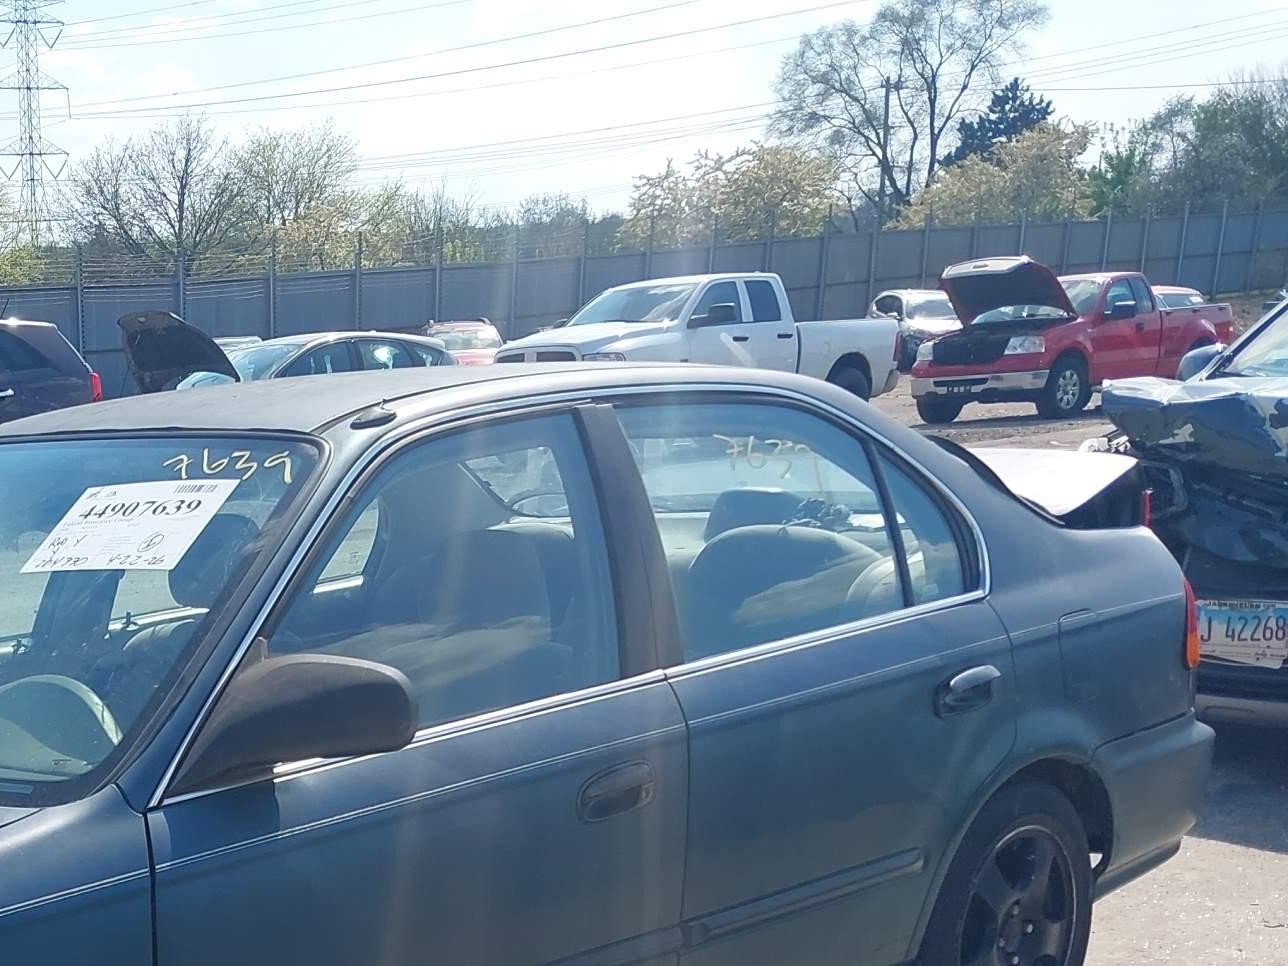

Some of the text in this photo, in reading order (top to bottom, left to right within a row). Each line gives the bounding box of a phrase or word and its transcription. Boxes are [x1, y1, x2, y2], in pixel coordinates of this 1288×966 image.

[162, 448, 292, 485] 7639
[78, 499, 202, 520] 44907639
[1200, 615, 1287, 642] J 42268
